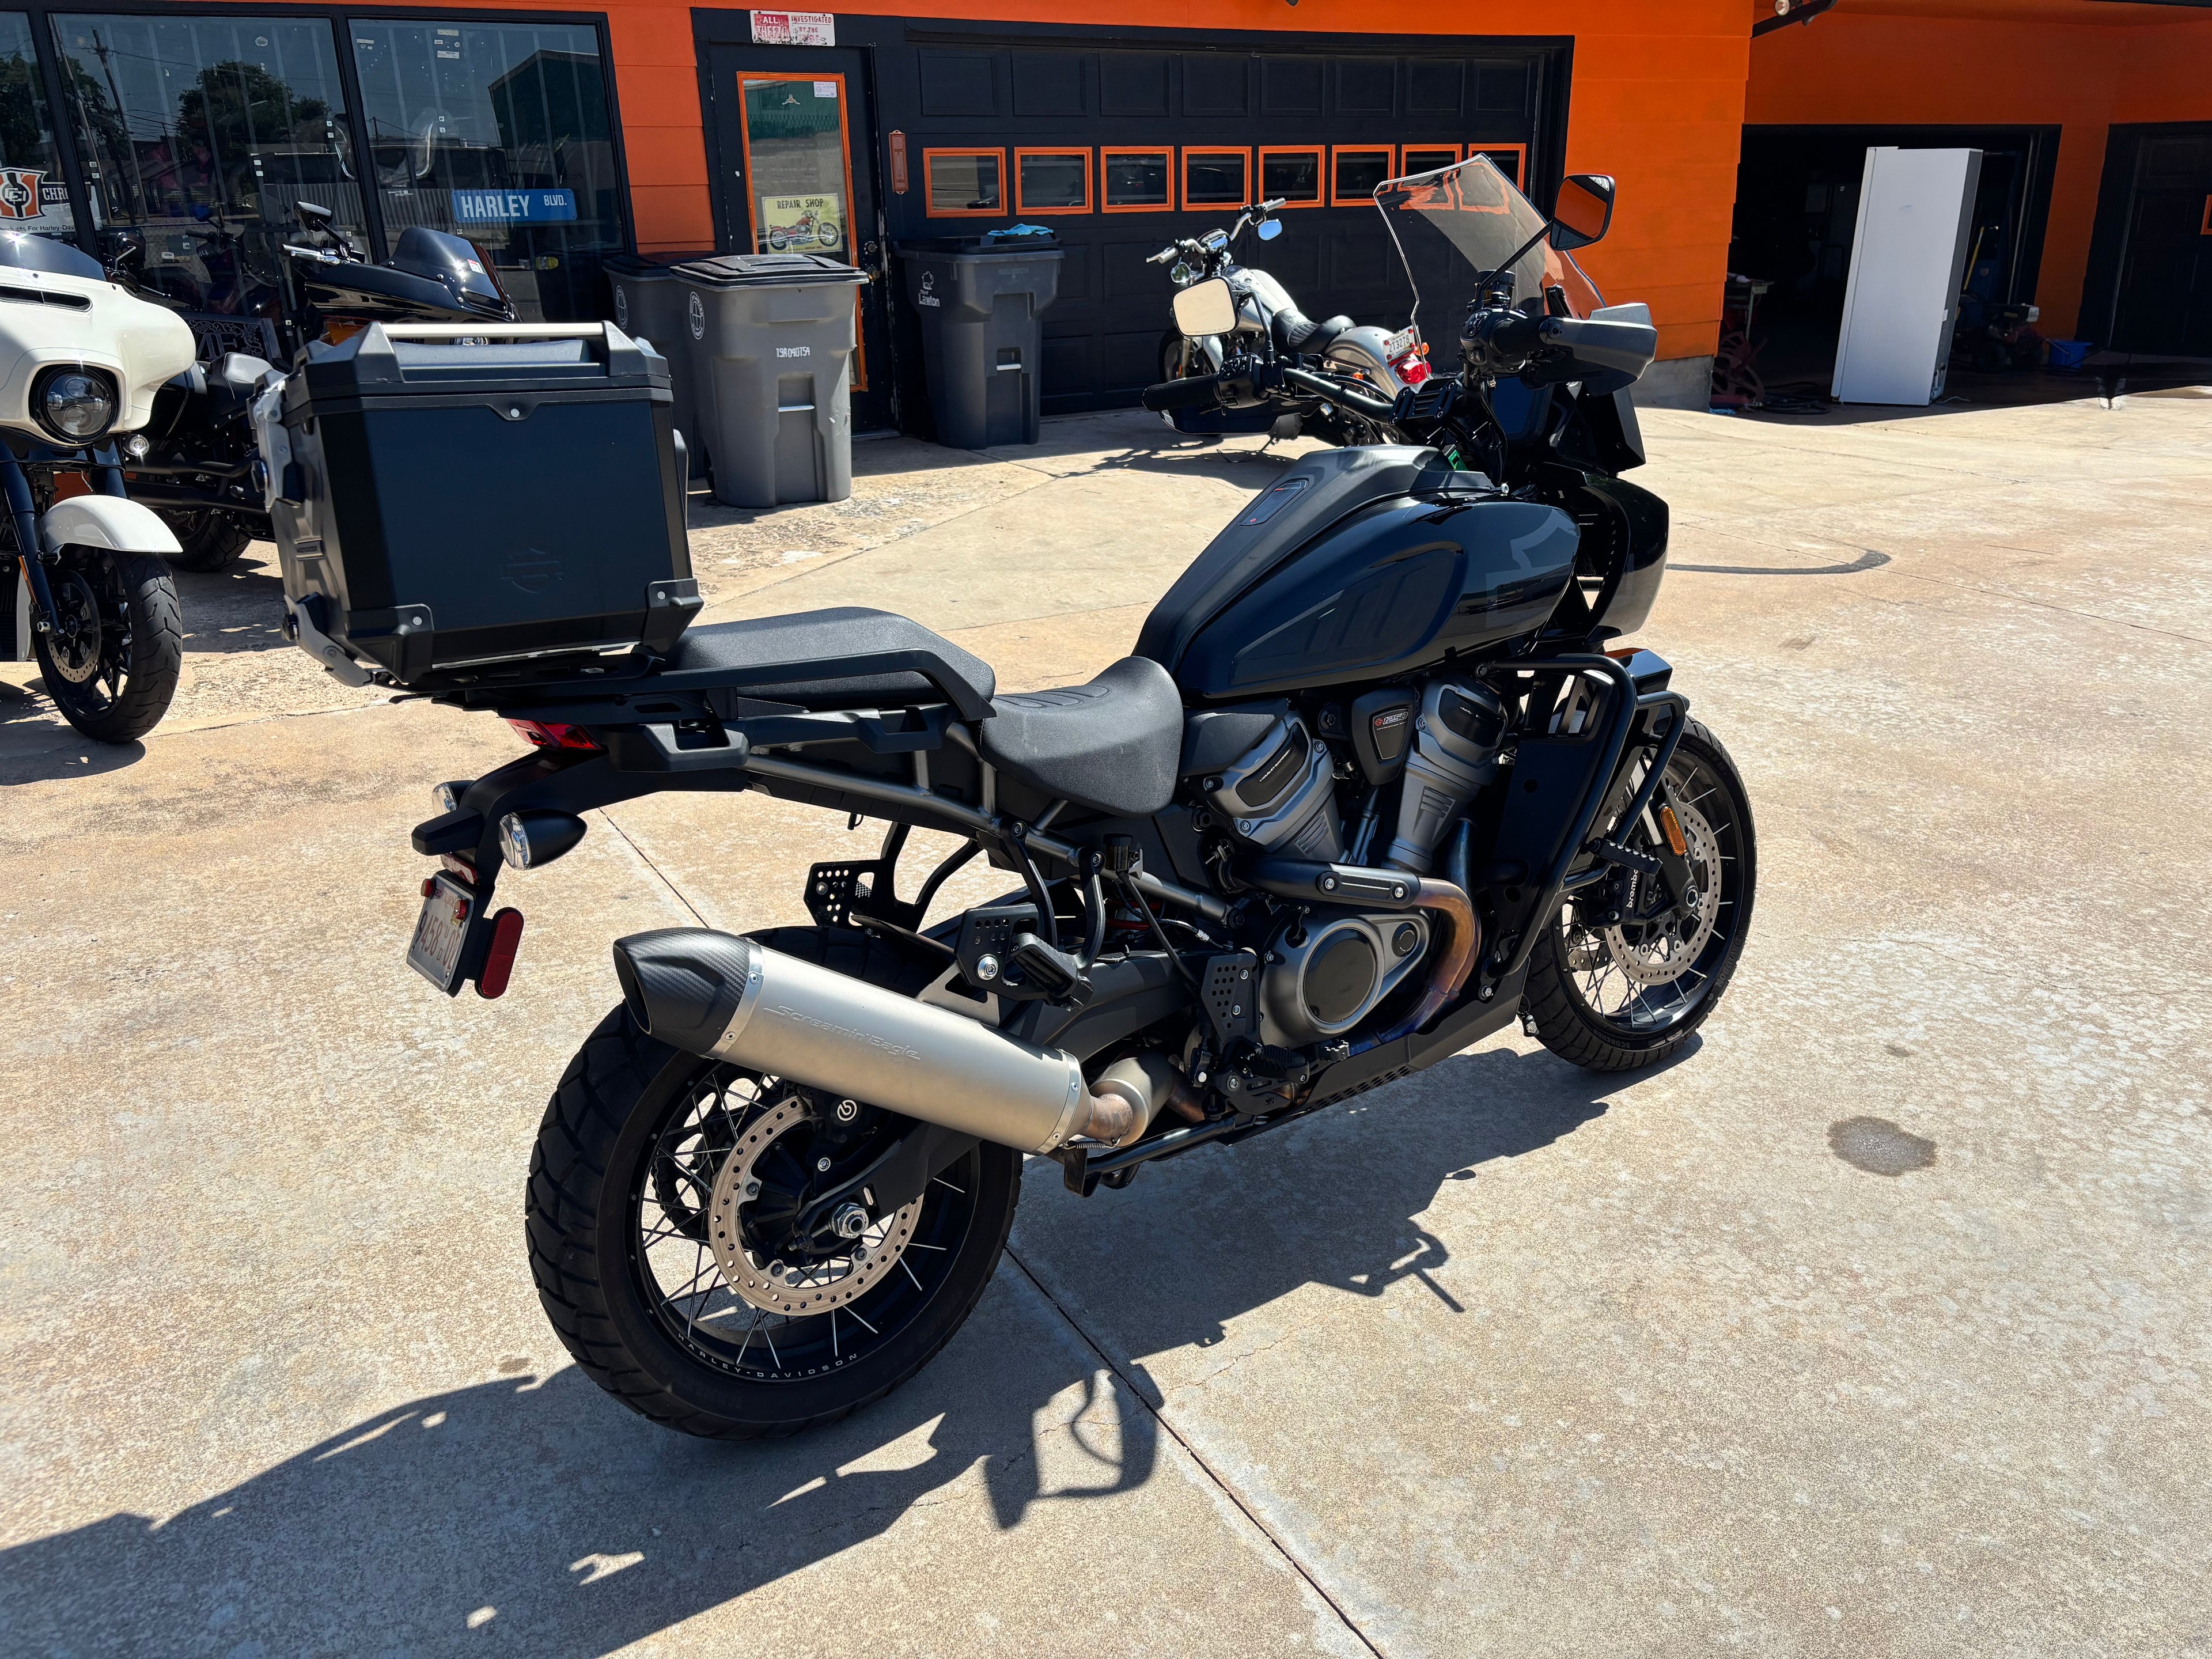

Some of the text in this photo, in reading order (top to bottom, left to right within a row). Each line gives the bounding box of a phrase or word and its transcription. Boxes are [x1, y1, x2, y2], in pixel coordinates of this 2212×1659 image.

[763, 16, 778, 24] ALL
[791, 15, 832, 24] INVESTIGATED
[42, 187, 69, 200] CHR
[460, 194, 567, 218] HARLEY BLVD.
[777, 198, 824, 209] REPAIR SHOP
[1389, 335, 1410, 353] 2T3278
[1382, 711, 1408, 725] 1250
[1626, 869, 1638, 908] brembo
[866, 1035, 921, 1060] Eagle
[677, 1332, 857, 1378] HARLEY-DAVIDSON
